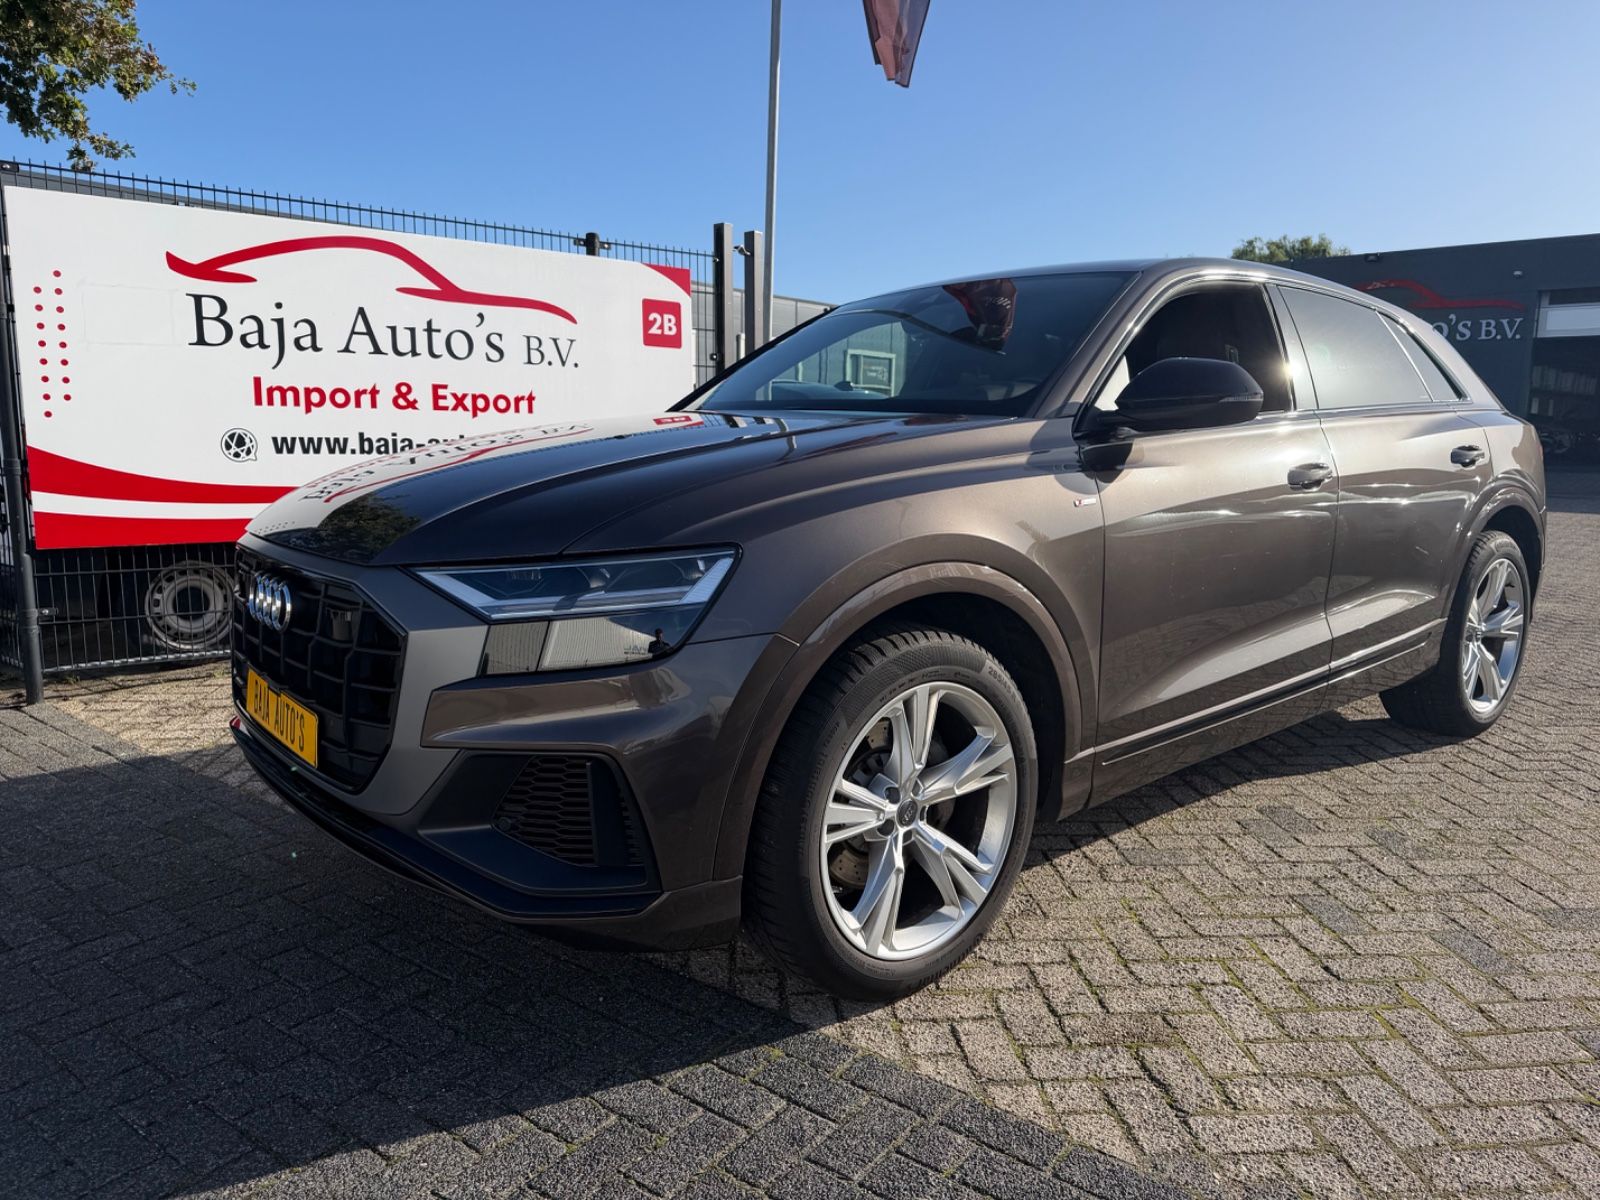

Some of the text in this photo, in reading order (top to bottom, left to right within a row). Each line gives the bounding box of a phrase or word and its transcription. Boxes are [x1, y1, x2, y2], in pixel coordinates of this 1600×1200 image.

[185, 292, 580, 370] Baja Auto's B.V.
[647, 311, 678, 336] 2B
[1477, 317, 1524, 340] B.V.
[252, 376, 536, 419] Import & Export
[271, 431, 465, 456] www.baja-
[273, 694, 306, 753] AUTO'S
